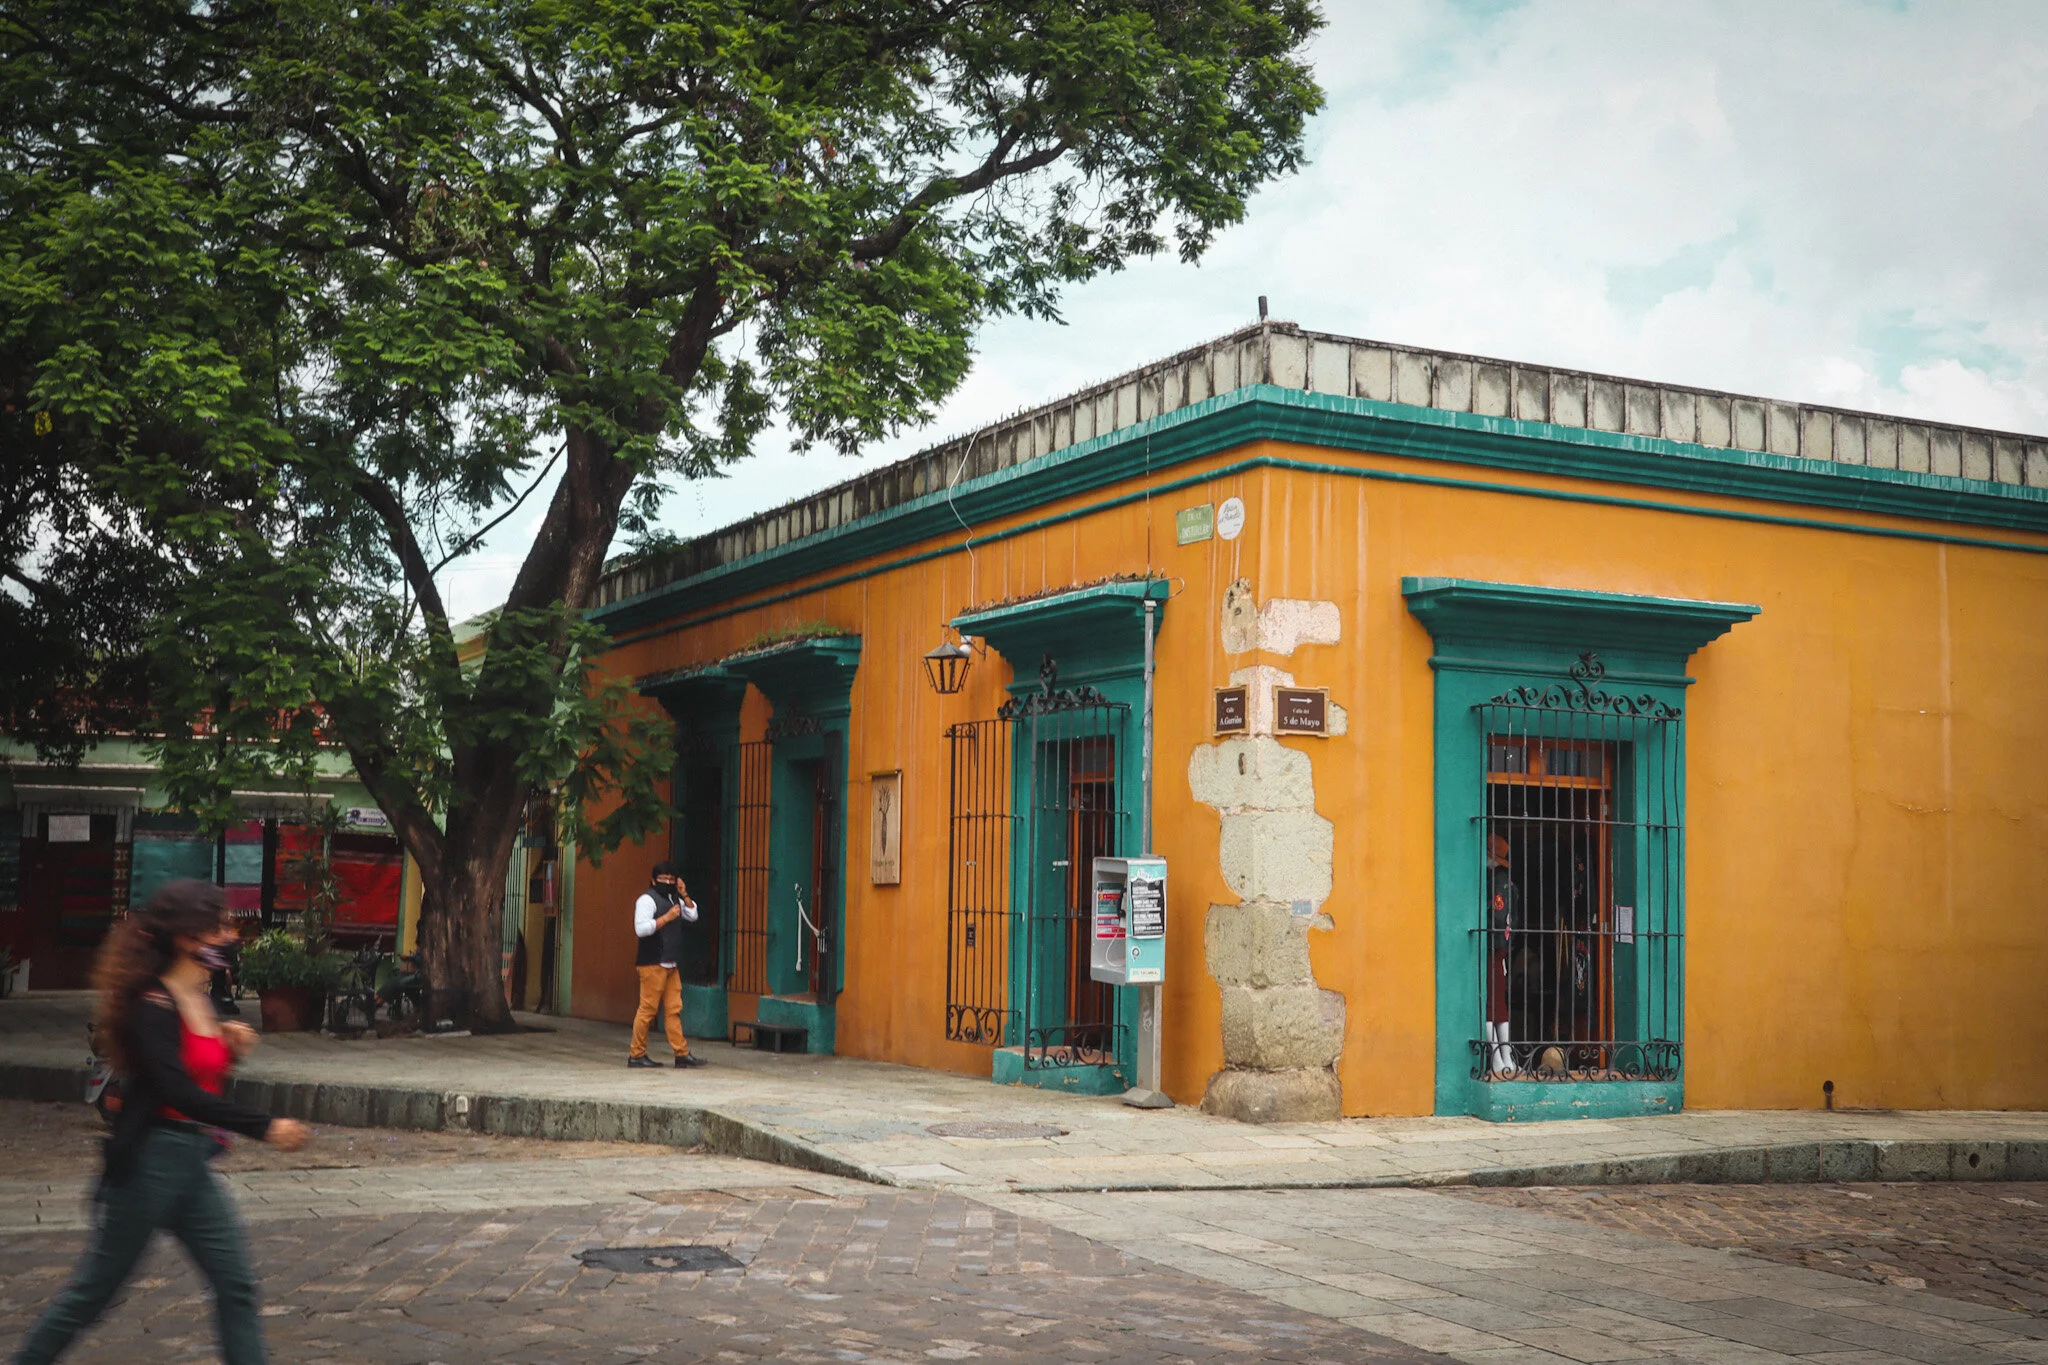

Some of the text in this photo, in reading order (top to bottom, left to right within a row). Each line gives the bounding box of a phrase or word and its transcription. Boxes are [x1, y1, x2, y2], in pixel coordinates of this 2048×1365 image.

[1283, 716, 1320, 728] 5 de Mayo
